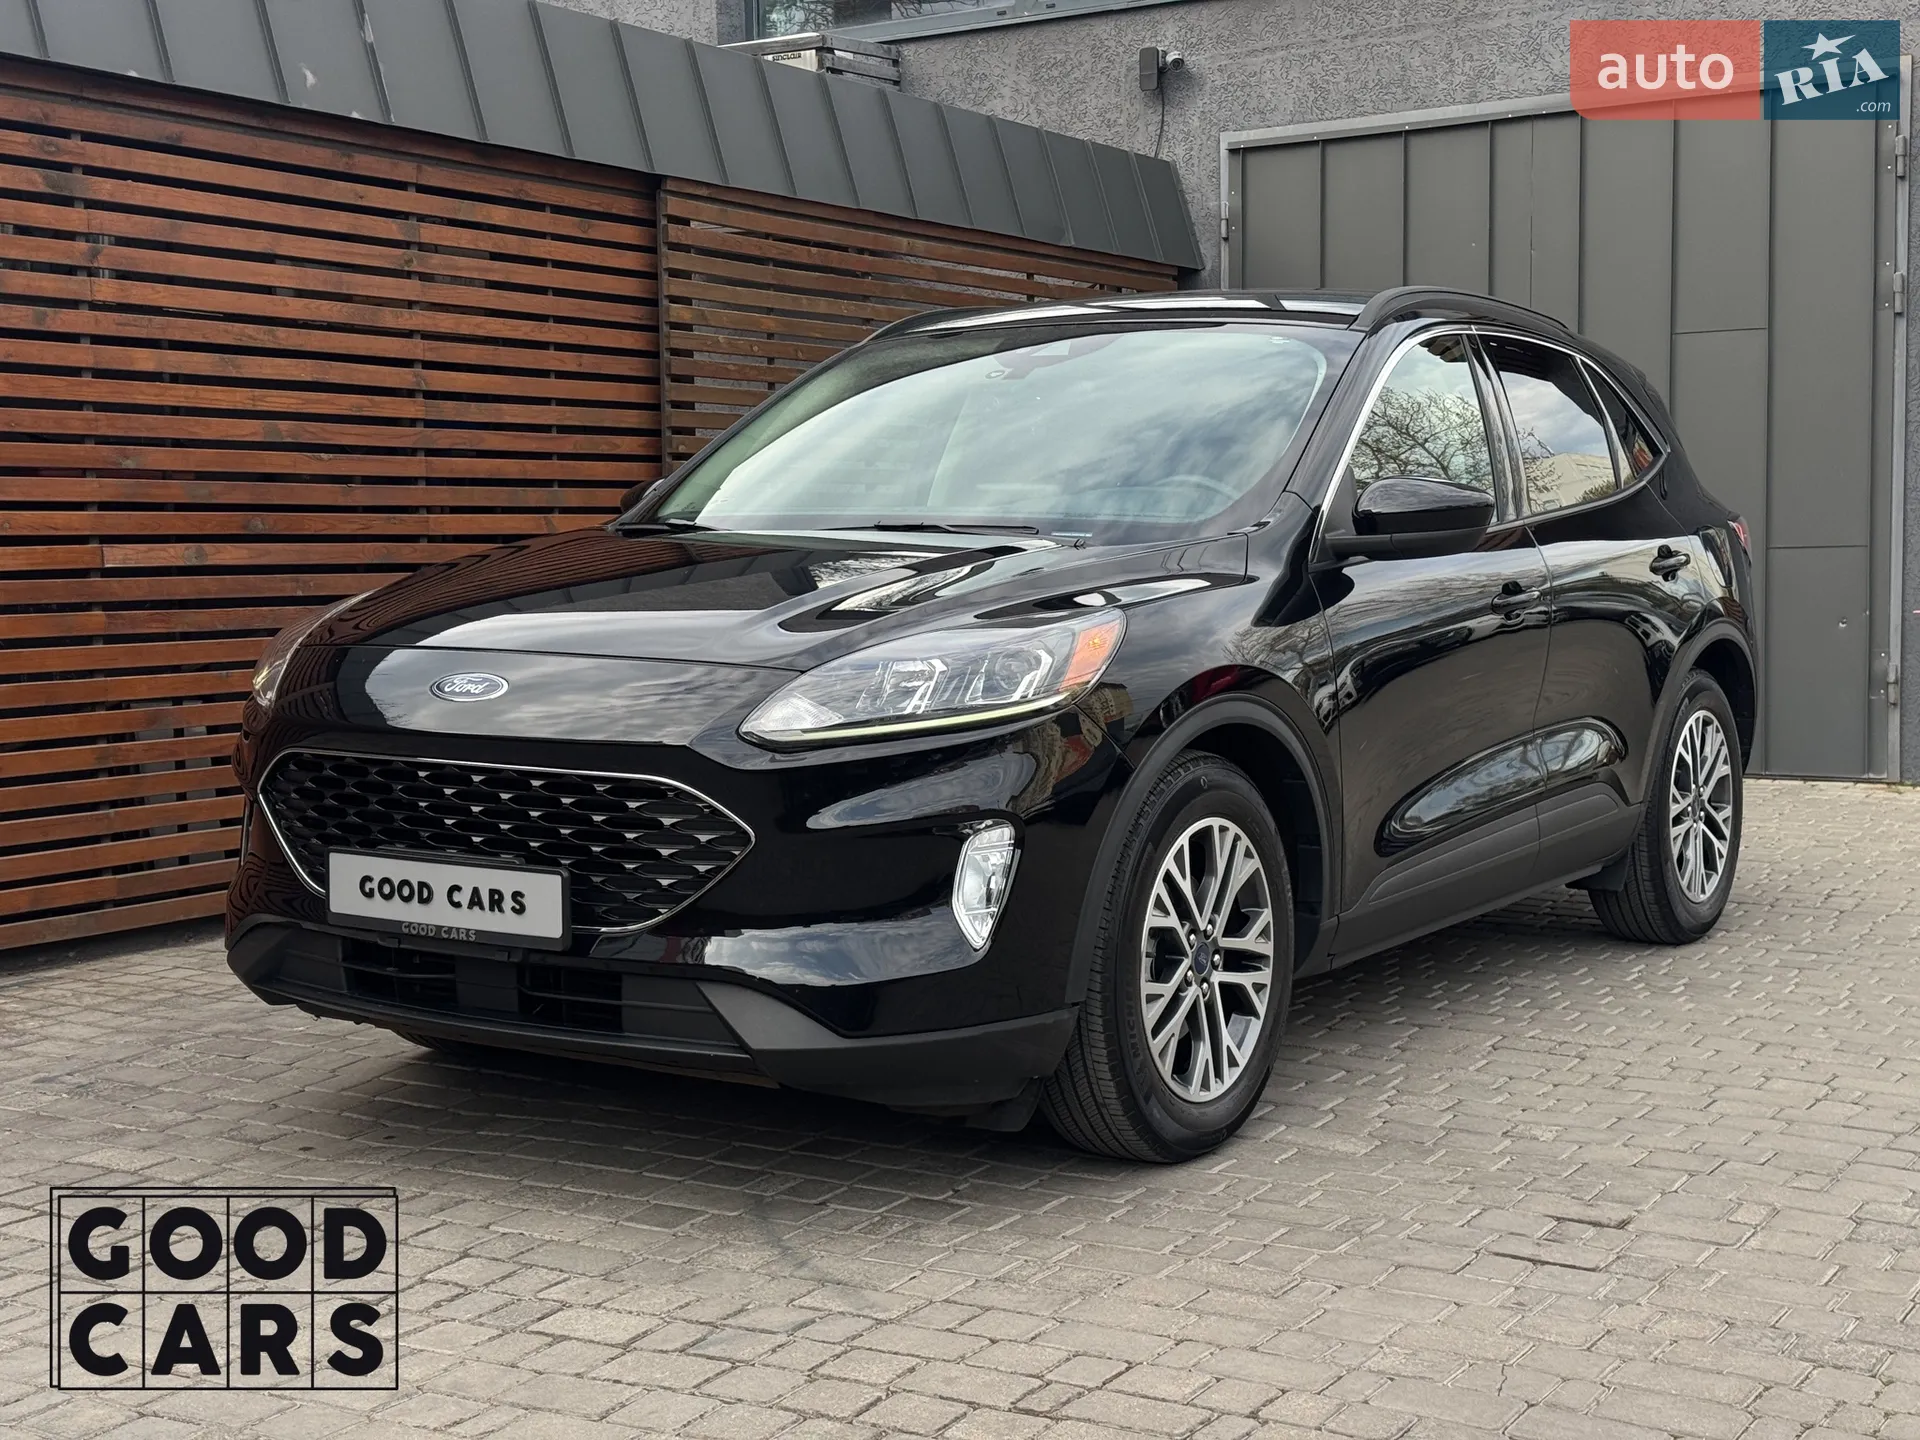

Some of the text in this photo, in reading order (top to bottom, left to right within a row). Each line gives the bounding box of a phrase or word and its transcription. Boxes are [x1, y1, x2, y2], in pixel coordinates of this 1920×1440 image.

[444, 677, 490, 694] Ford
[359, 875, 527, 915] GOOD CARS
[401, 922, 477, 942] GOOD CARS
